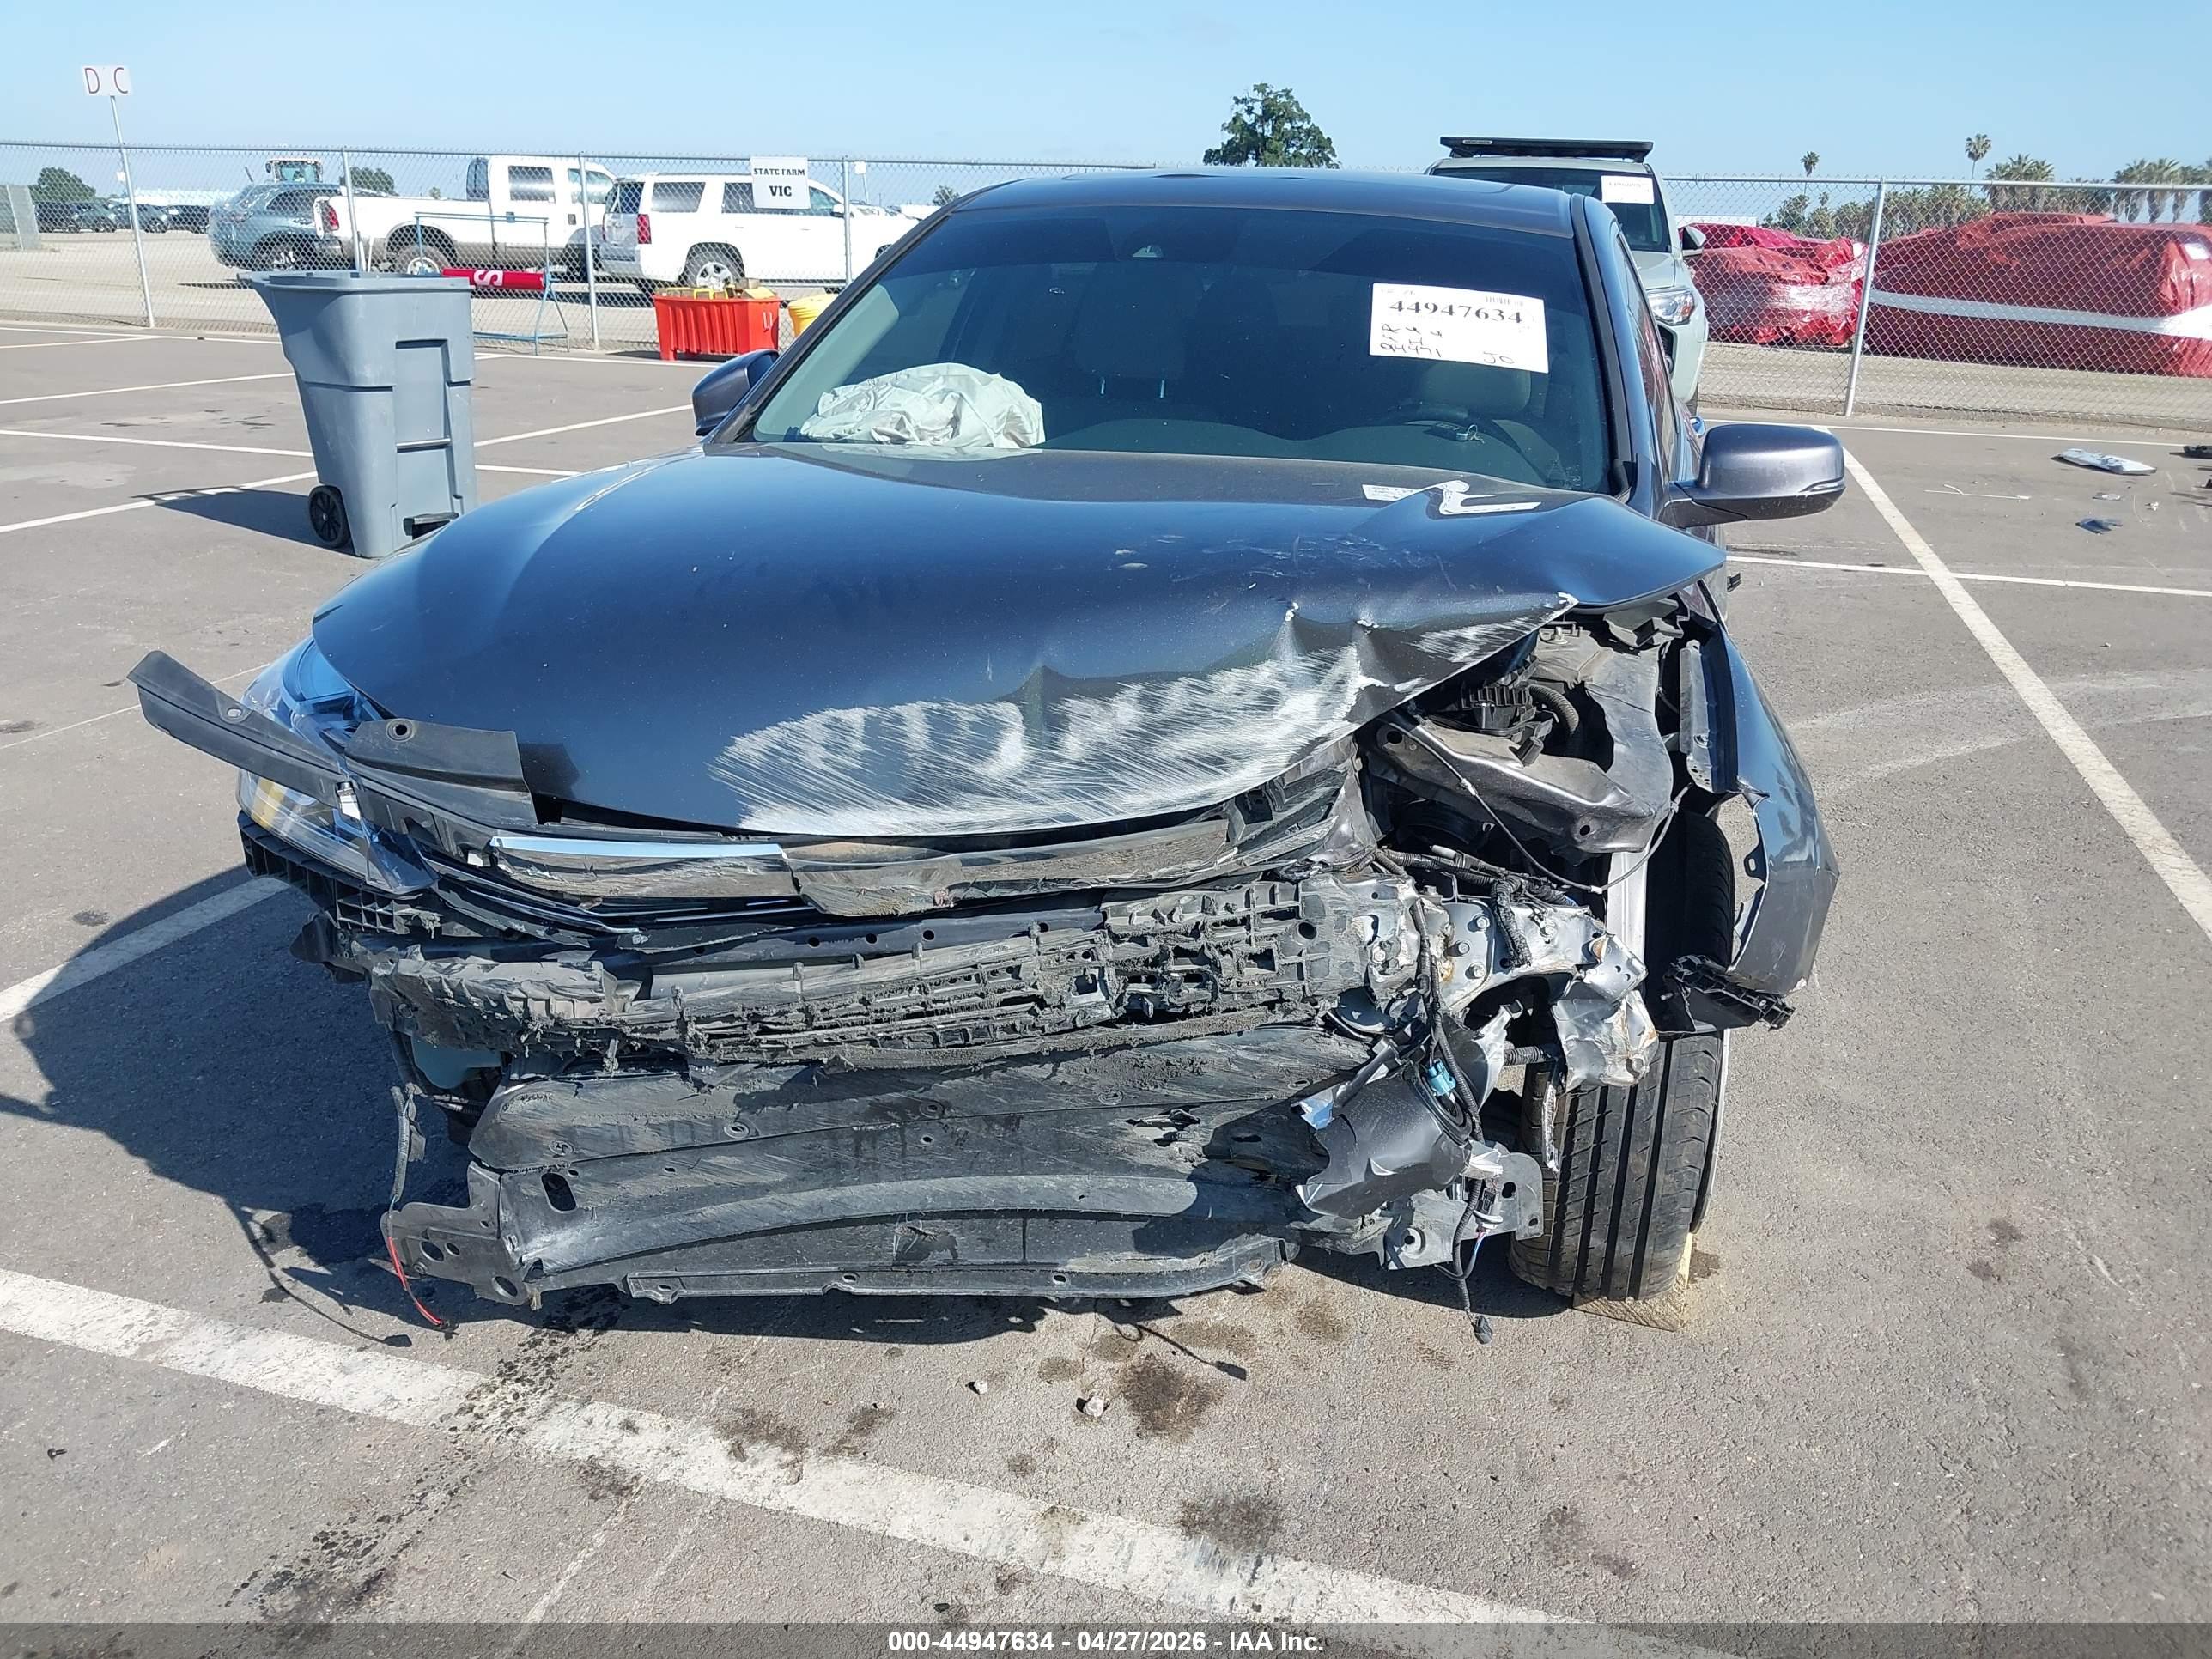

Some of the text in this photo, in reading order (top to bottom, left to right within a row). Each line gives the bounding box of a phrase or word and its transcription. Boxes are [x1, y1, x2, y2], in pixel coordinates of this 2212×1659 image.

[84, 67, 129, 94] D C
[753, 167, 780, 176] STATE
[769, 185, 792, 198] VIC
[1389, 301, 1522, 324] 44947634
